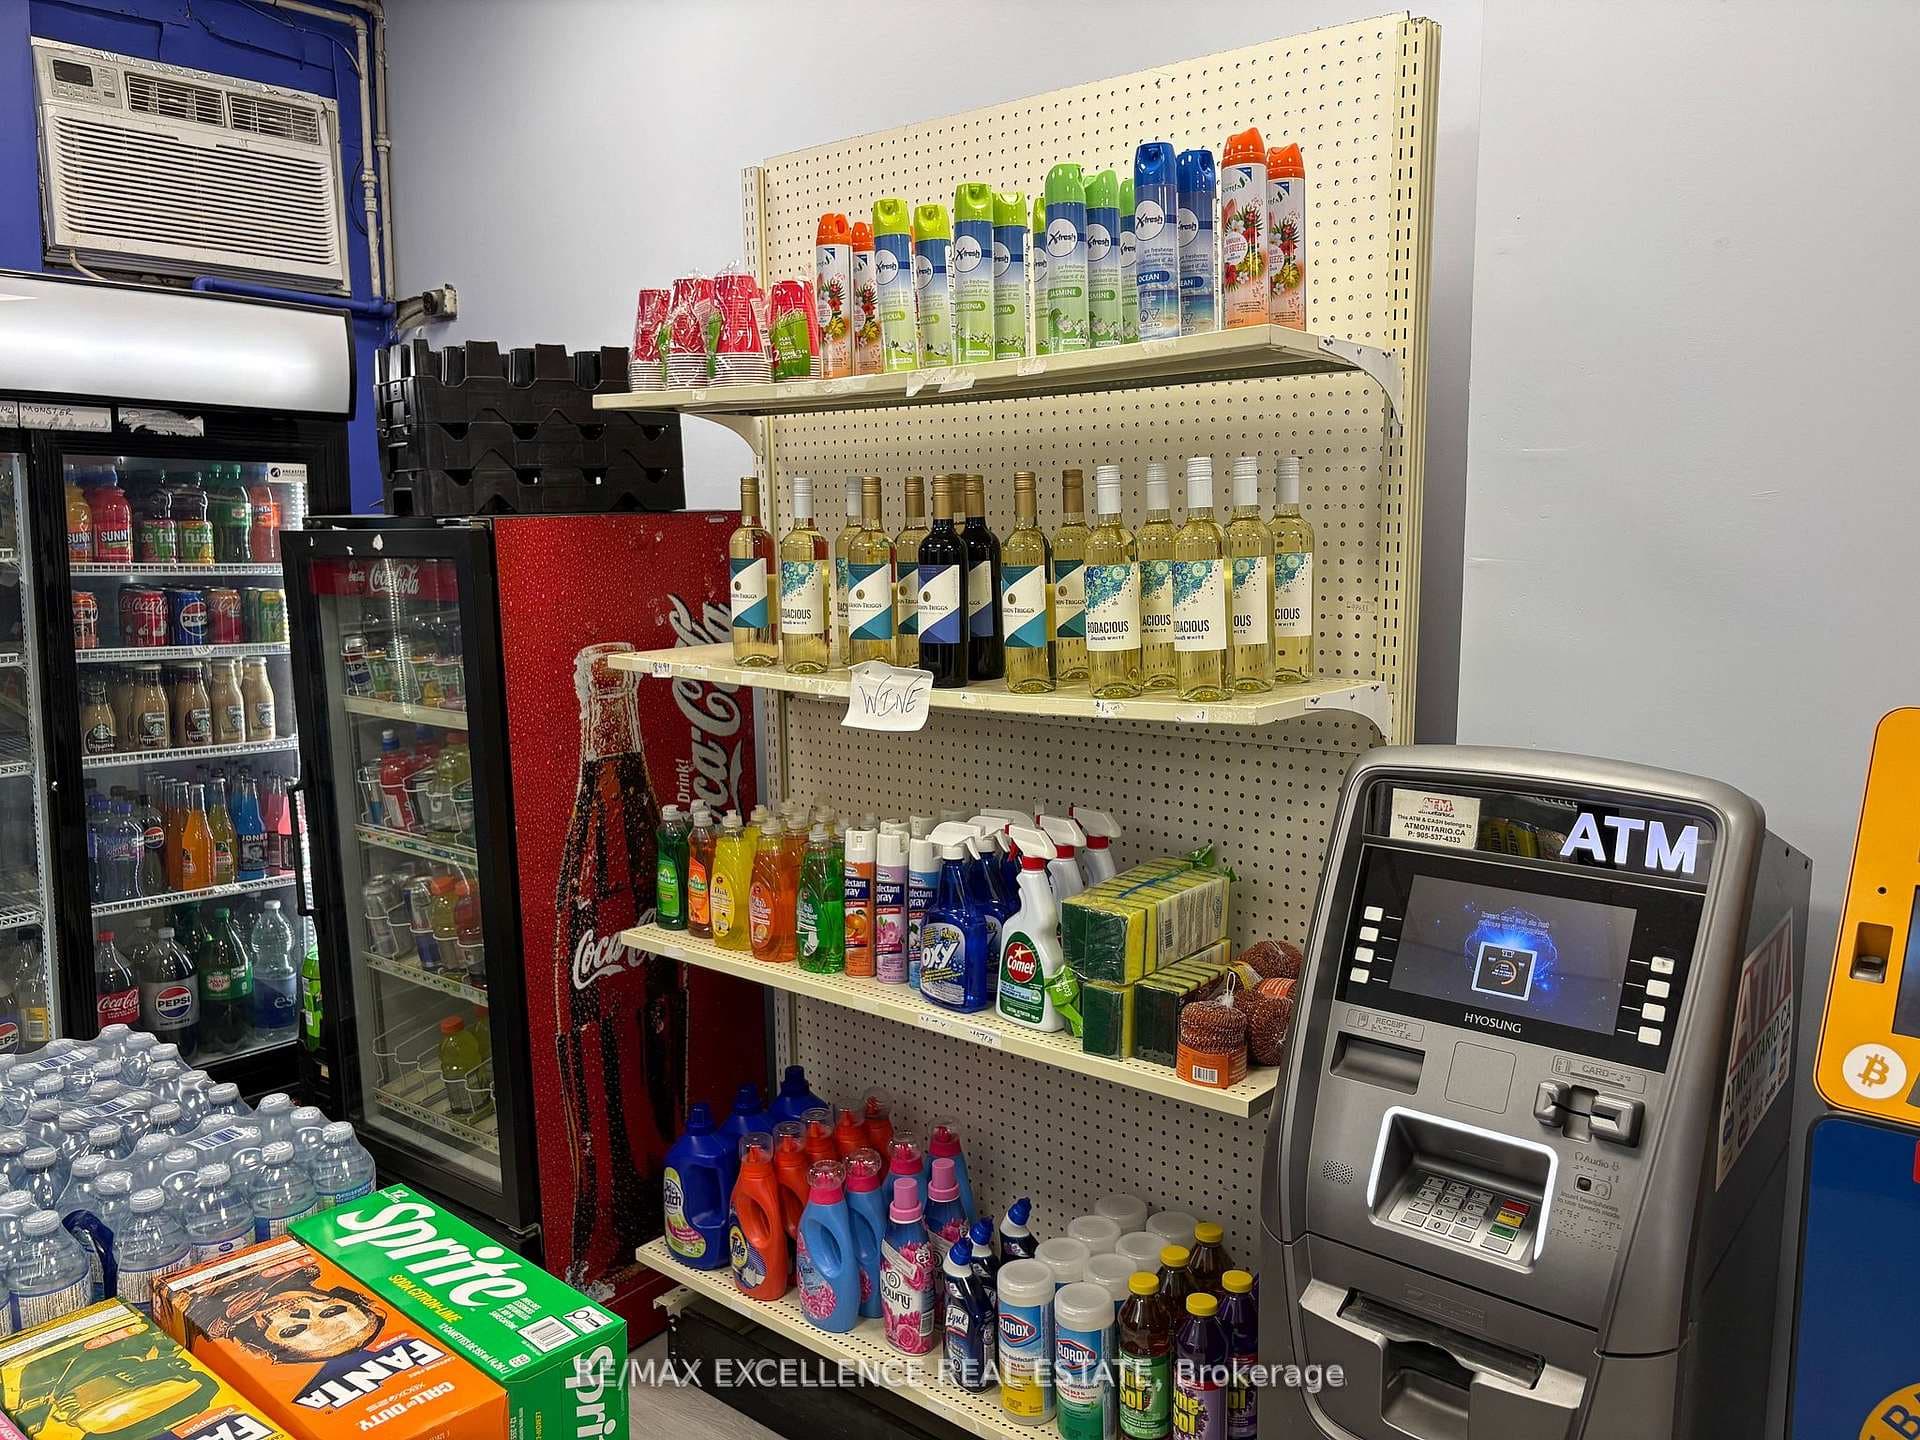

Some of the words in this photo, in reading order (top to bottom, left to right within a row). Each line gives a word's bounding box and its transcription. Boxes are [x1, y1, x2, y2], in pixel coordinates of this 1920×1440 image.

[1138, 273, 1160, 283] OCEAN
[1180, 279, 1194, 287] EAN
[22, 404, 74, 417] MONSTER
[1014, 607, 1035, 615] TRIGGS
[1143, 614, 1171, 627] ACIOUS
[859, 674, 925, 717] WINE
[676, 758, 691, 804] Drink!
[1404, 822, 1466, 837] ATMONTARIO.CA
[1409, 815, 1422, 823] ATM
[1427, 817, 1444, 825] CASH
[1444, 819, 1465, 829] belongs
[1407, 830, 1415, 838] P:
[1416, 831, 1461, 844] 905-537-4333
[1560, 812, 1699, 874] ATM
[921, 941, 960, 969] OXY
[1007, 955, 1035, 975] Comet
[157, 996, 192, 1009] PEPSI
[1375, 1016, 1409, 1032] RECEIPT
[1464, 1011, 1522, 1034] HYOSUNG
[1582, 1064, 1609, 1079] CARD
[1584, 1155, 1609, 1169] Audio
[1420, 1189, 1427, 1197] 4
[1473, 1191, 1480, 1200] 3
[1435, 1208, 1442, 1216] 8
[1467, 1203, 1474, 1211] 6
[1434, 1222, 1440, 1230] 0
[731, 1235, 745, 1254] Tide
[334, 1202, 528, 1308] Sprite
[295, 1338, 446, 1410] FANTA
[410, 1380, 456, 1407] CALL
[565, 1345, 616, 1440] Spri
[357, 1402, 409, 1433] DUTY
